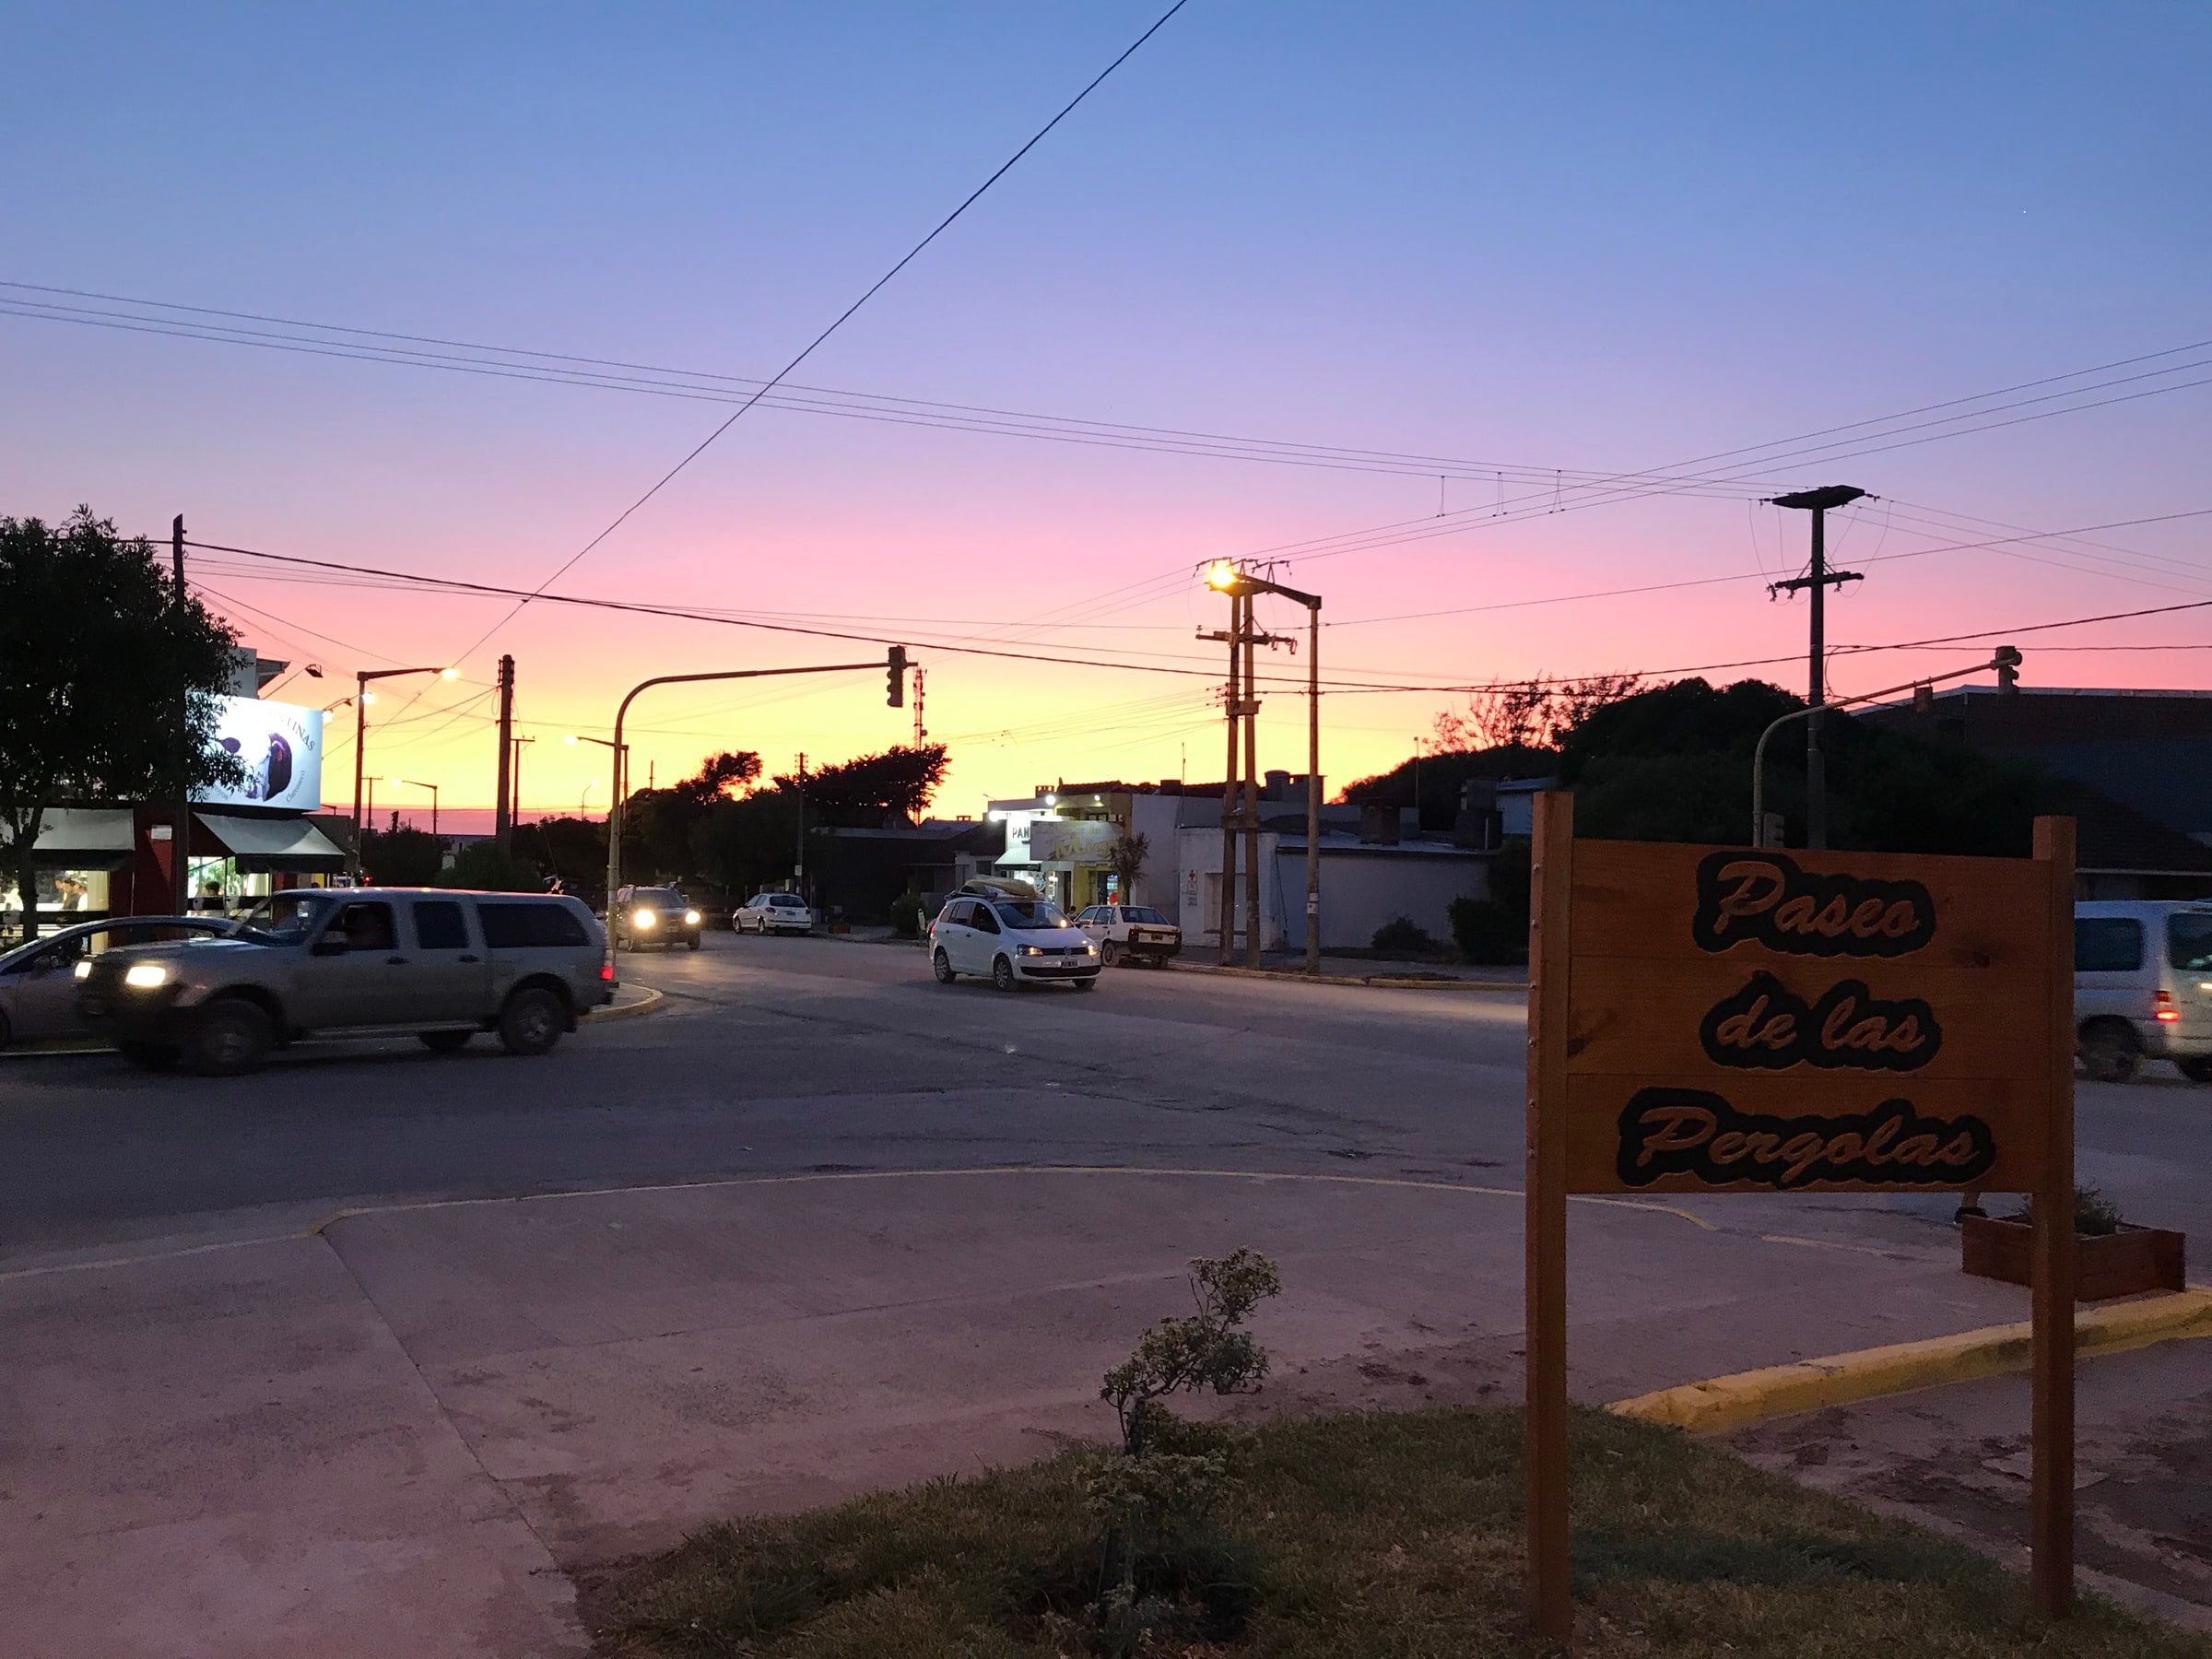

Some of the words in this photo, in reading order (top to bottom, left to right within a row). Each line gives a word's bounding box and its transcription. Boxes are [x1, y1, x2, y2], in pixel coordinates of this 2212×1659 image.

[1712, 860, 1921, 938] Paseo
[1716, 994, 1798, 1051] de
[1820, 995, 1926, 1052] las
[1636, 1105, 1983, 1183] Pergolas
